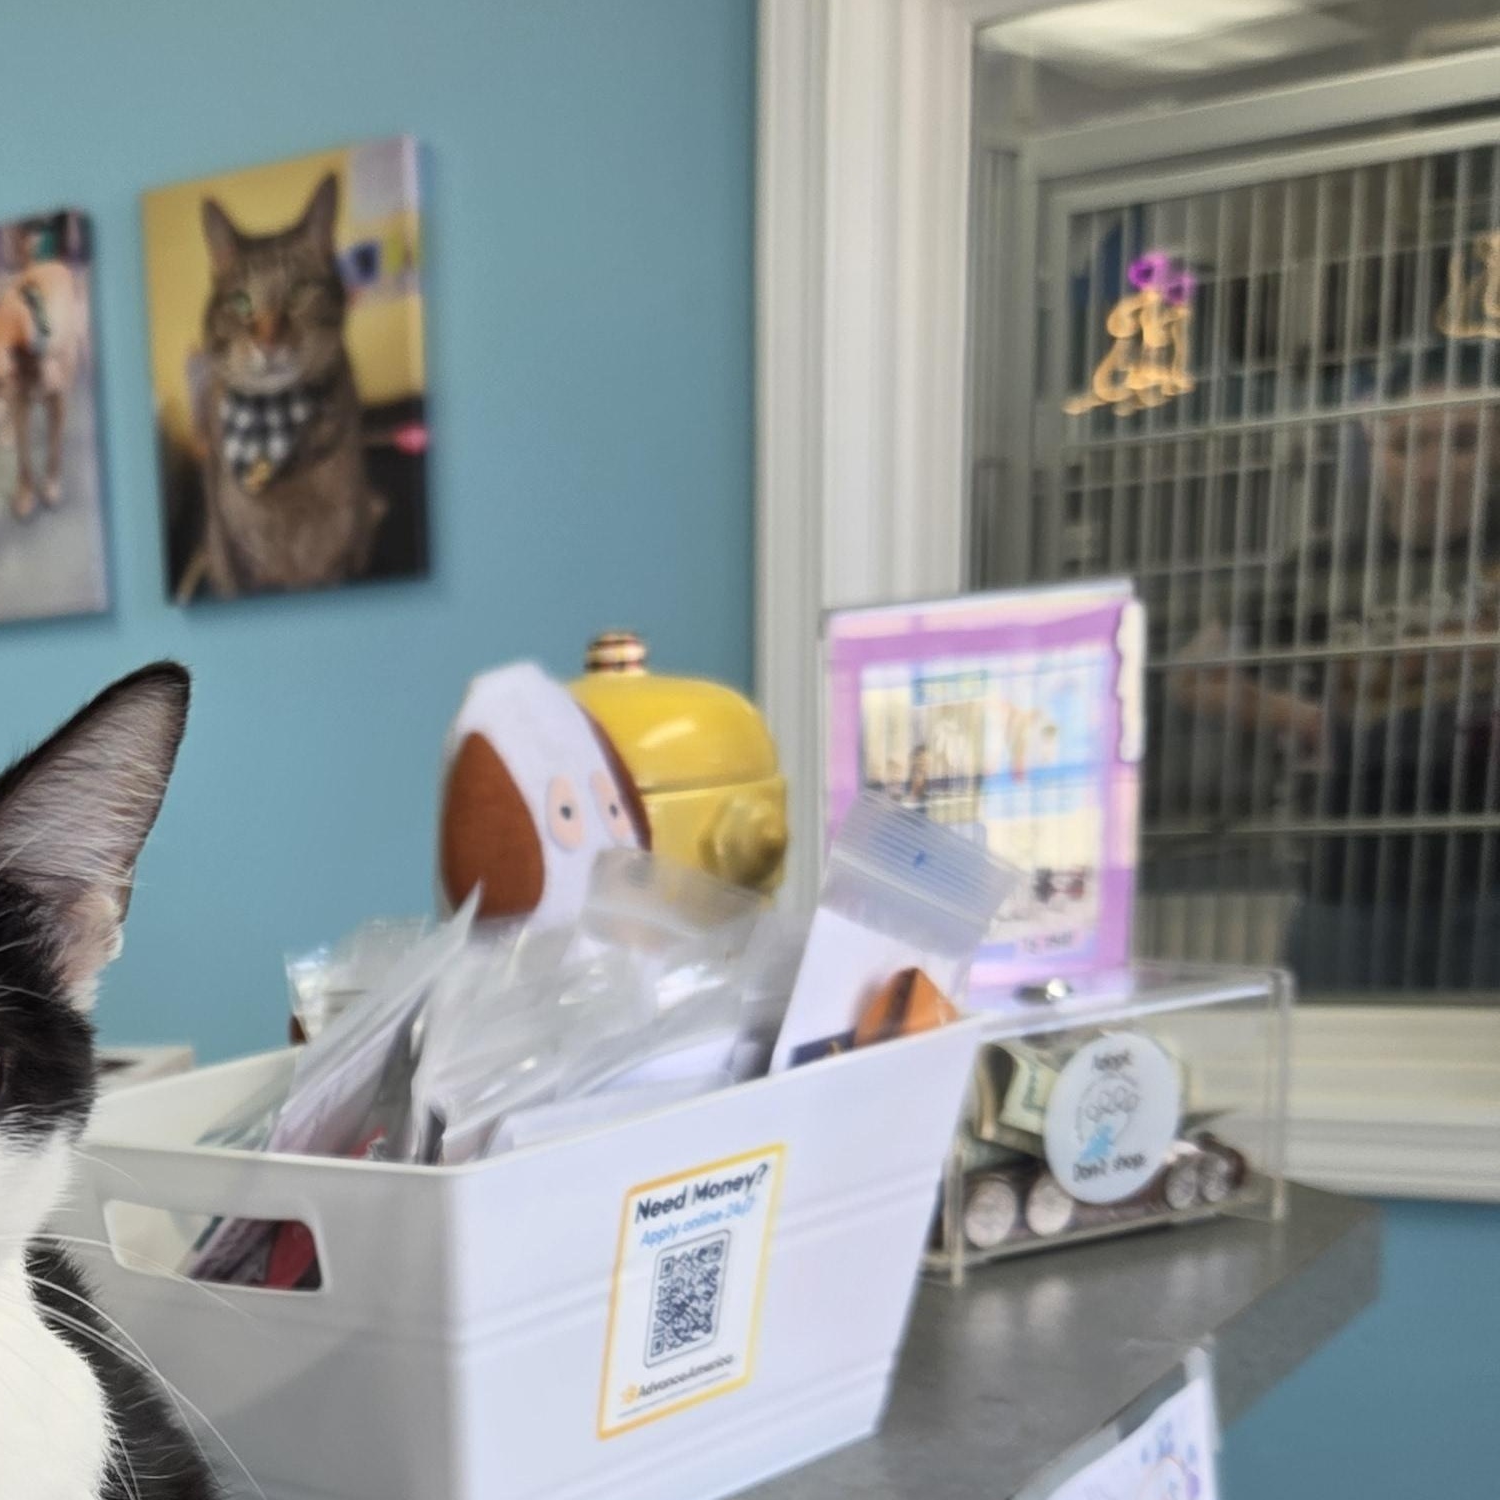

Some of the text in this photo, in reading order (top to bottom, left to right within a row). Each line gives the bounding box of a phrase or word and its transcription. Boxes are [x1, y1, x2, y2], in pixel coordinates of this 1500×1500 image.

[634, 1163, 768, 1224] Need Money?
[640, 1222, 680, 1248] Apply
[682, 1210, 723, 1232] online
